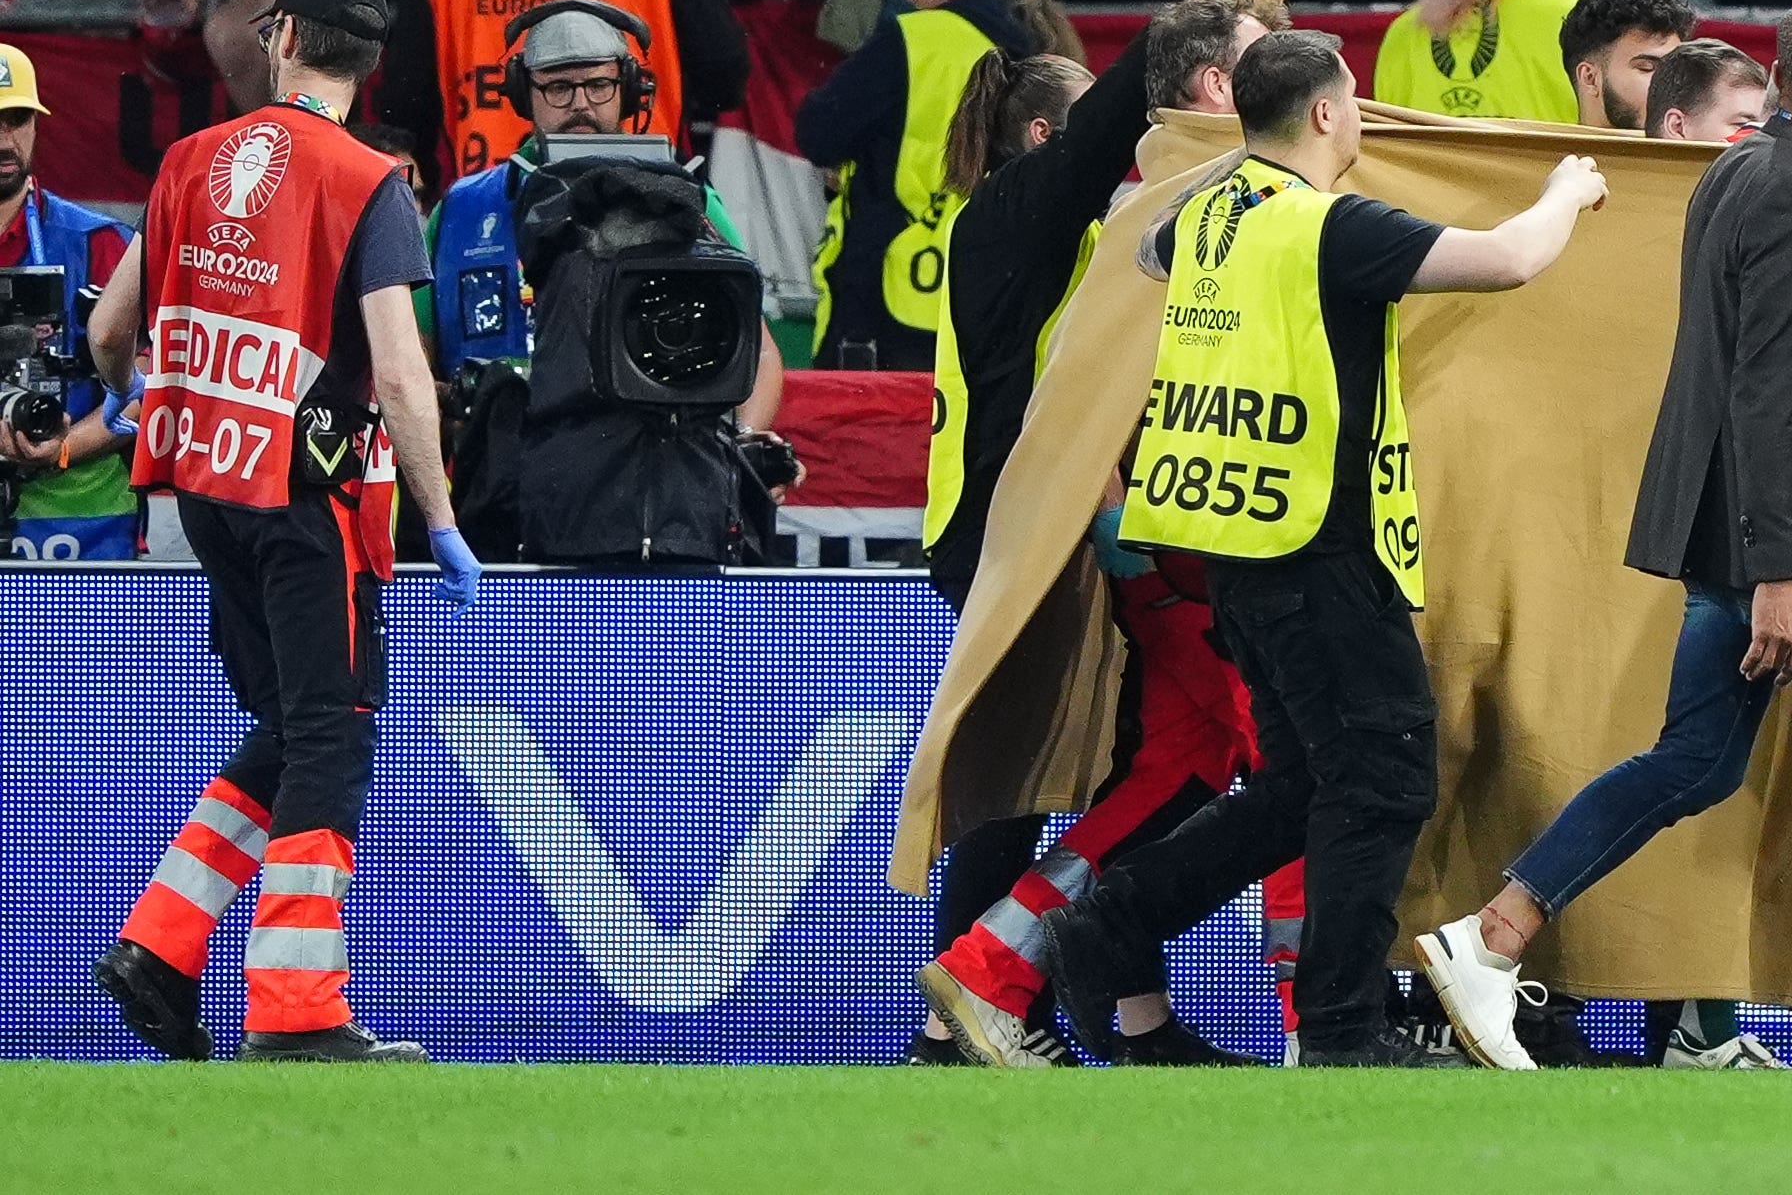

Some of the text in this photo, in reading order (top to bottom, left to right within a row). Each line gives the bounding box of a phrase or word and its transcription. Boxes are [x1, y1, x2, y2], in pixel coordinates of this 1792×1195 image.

[208, 224, 252, 250] UEFA
[178, 243, 280, 286] EURO2024
[198, 274, 256, 298] GERMANY
[1194, 282, 1218, 301] UEFA
[1165, 304, 1241, 332] EURO2024
[1177, 331, 1224, 349] GERMANY
[148, 318, 298, 404] EDICAL
[146, 404, 273, 481] 09-07
[1377, 442, 1417, 496] ST
[1129, 453, 1291, 523] -0855
